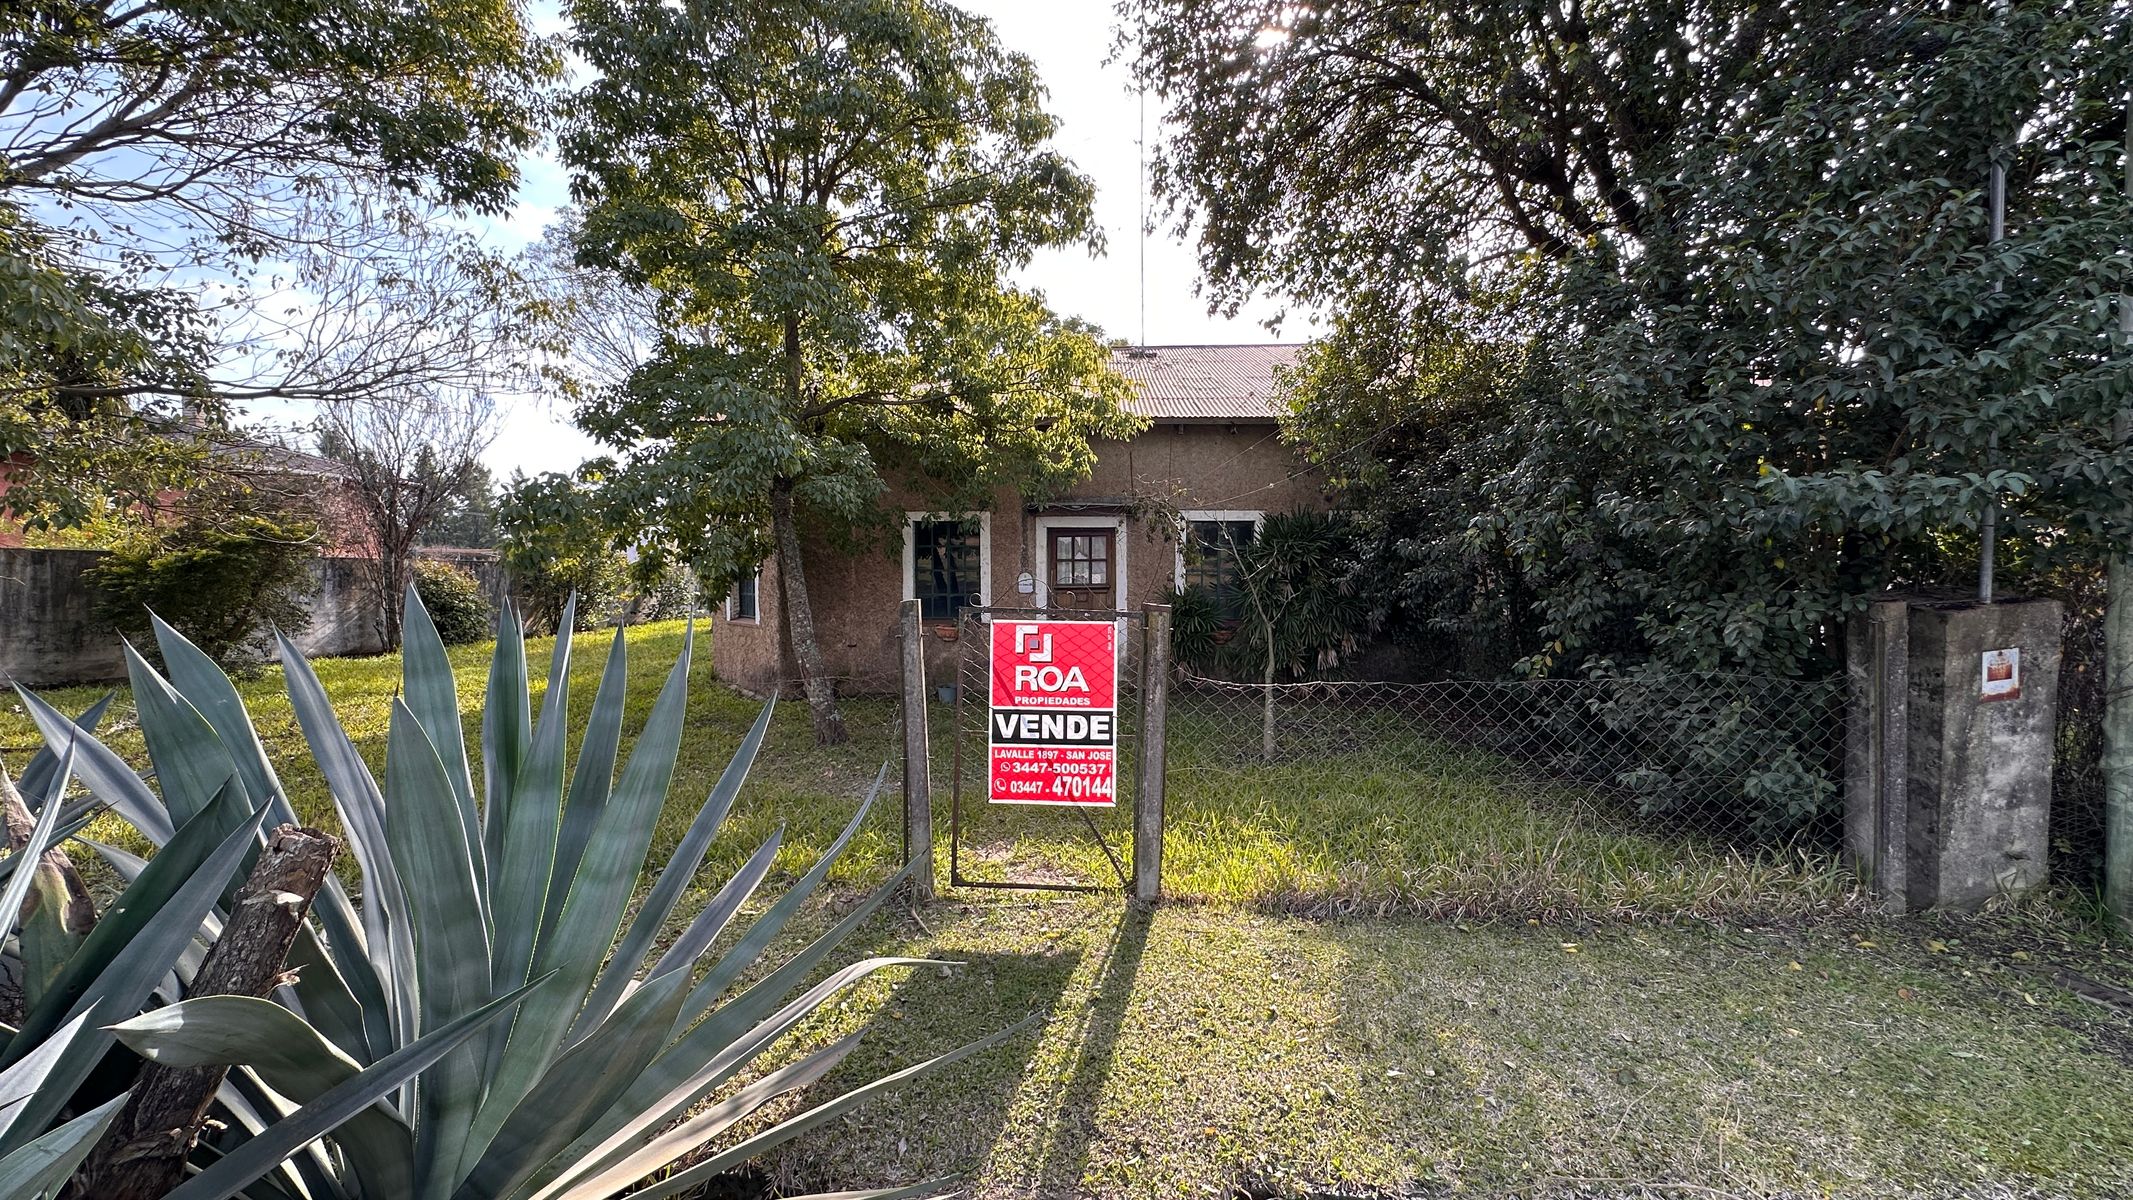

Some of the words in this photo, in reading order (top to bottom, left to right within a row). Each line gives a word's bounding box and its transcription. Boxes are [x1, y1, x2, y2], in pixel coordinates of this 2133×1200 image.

[1015, 665, 1090, 692] ROA
[1015, 696, 1090, 705] PROPIEDADES
[995, 714, 1110, 740] VENDE
[994, 750, 1034, 759] LAVALLE
[1037, 751, 1058, 760] 1897
[1066, 751, 1085, 760] SAN
[1087, 752, 1111, 760] JOSE
[1012, 762, 1106, 774] 3447-500537
[1010, 781, 1043, 794] 03447
[1052, 776, 1112, 797] 470144
